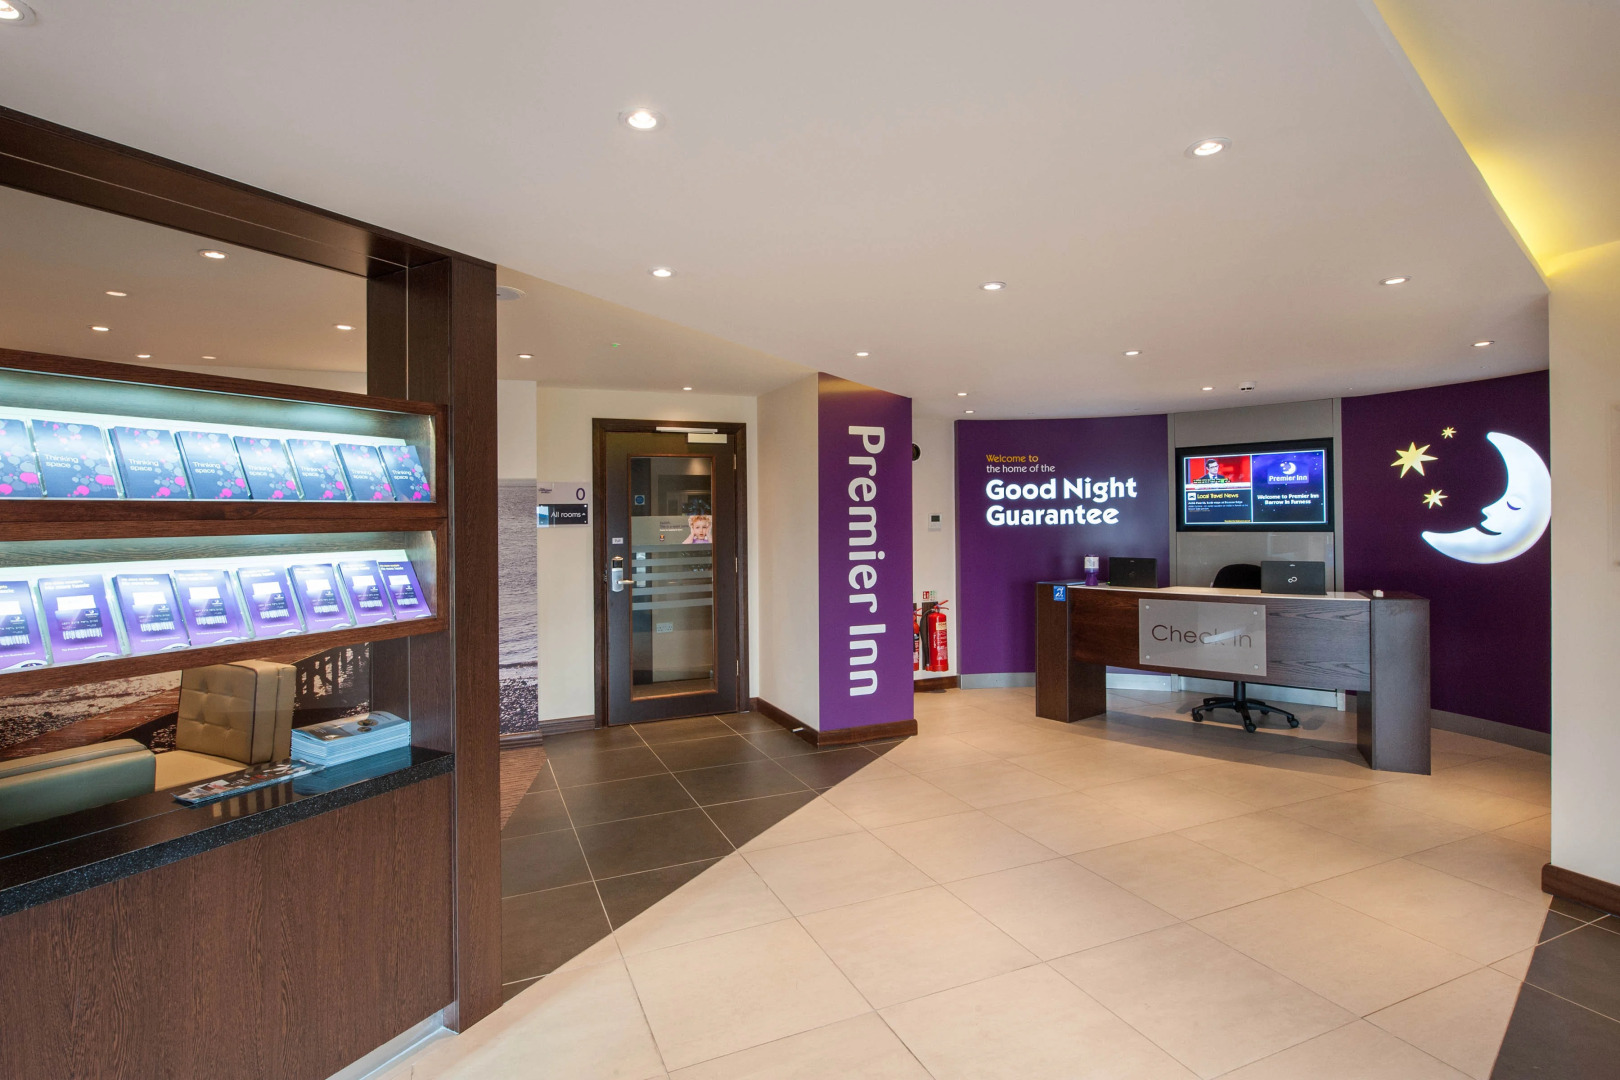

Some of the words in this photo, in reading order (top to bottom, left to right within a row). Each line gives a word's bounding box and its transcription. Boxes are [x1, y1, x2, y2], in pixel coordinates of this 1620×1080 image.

[44, 454, 79, 463] Thinking
[128, 458, 159, 467] Thinking
[986, 454, 1027, 463] Welcome
[1028, 455, 1039, 463] to
[192, 461, 221, 469] Thinking
[247, 464, 273, 473] Thinking
[986, 464, 1000, 473] the
[1002, 464, 1028, 473] home
[1029, 464, 1040, 473] of
[1041, 464, 1056, 473] the
[391, 469, 412, 477] Thinking
[576, 487, 586, 501] 0
[986, 478, 1056, 500] Good
[1063, 476, 1138, 503] Night
[848, 425, 886, 614] Premier
[985, 504, 1120, 527] Guarantee
[849, 623, 886, 697] Inn
